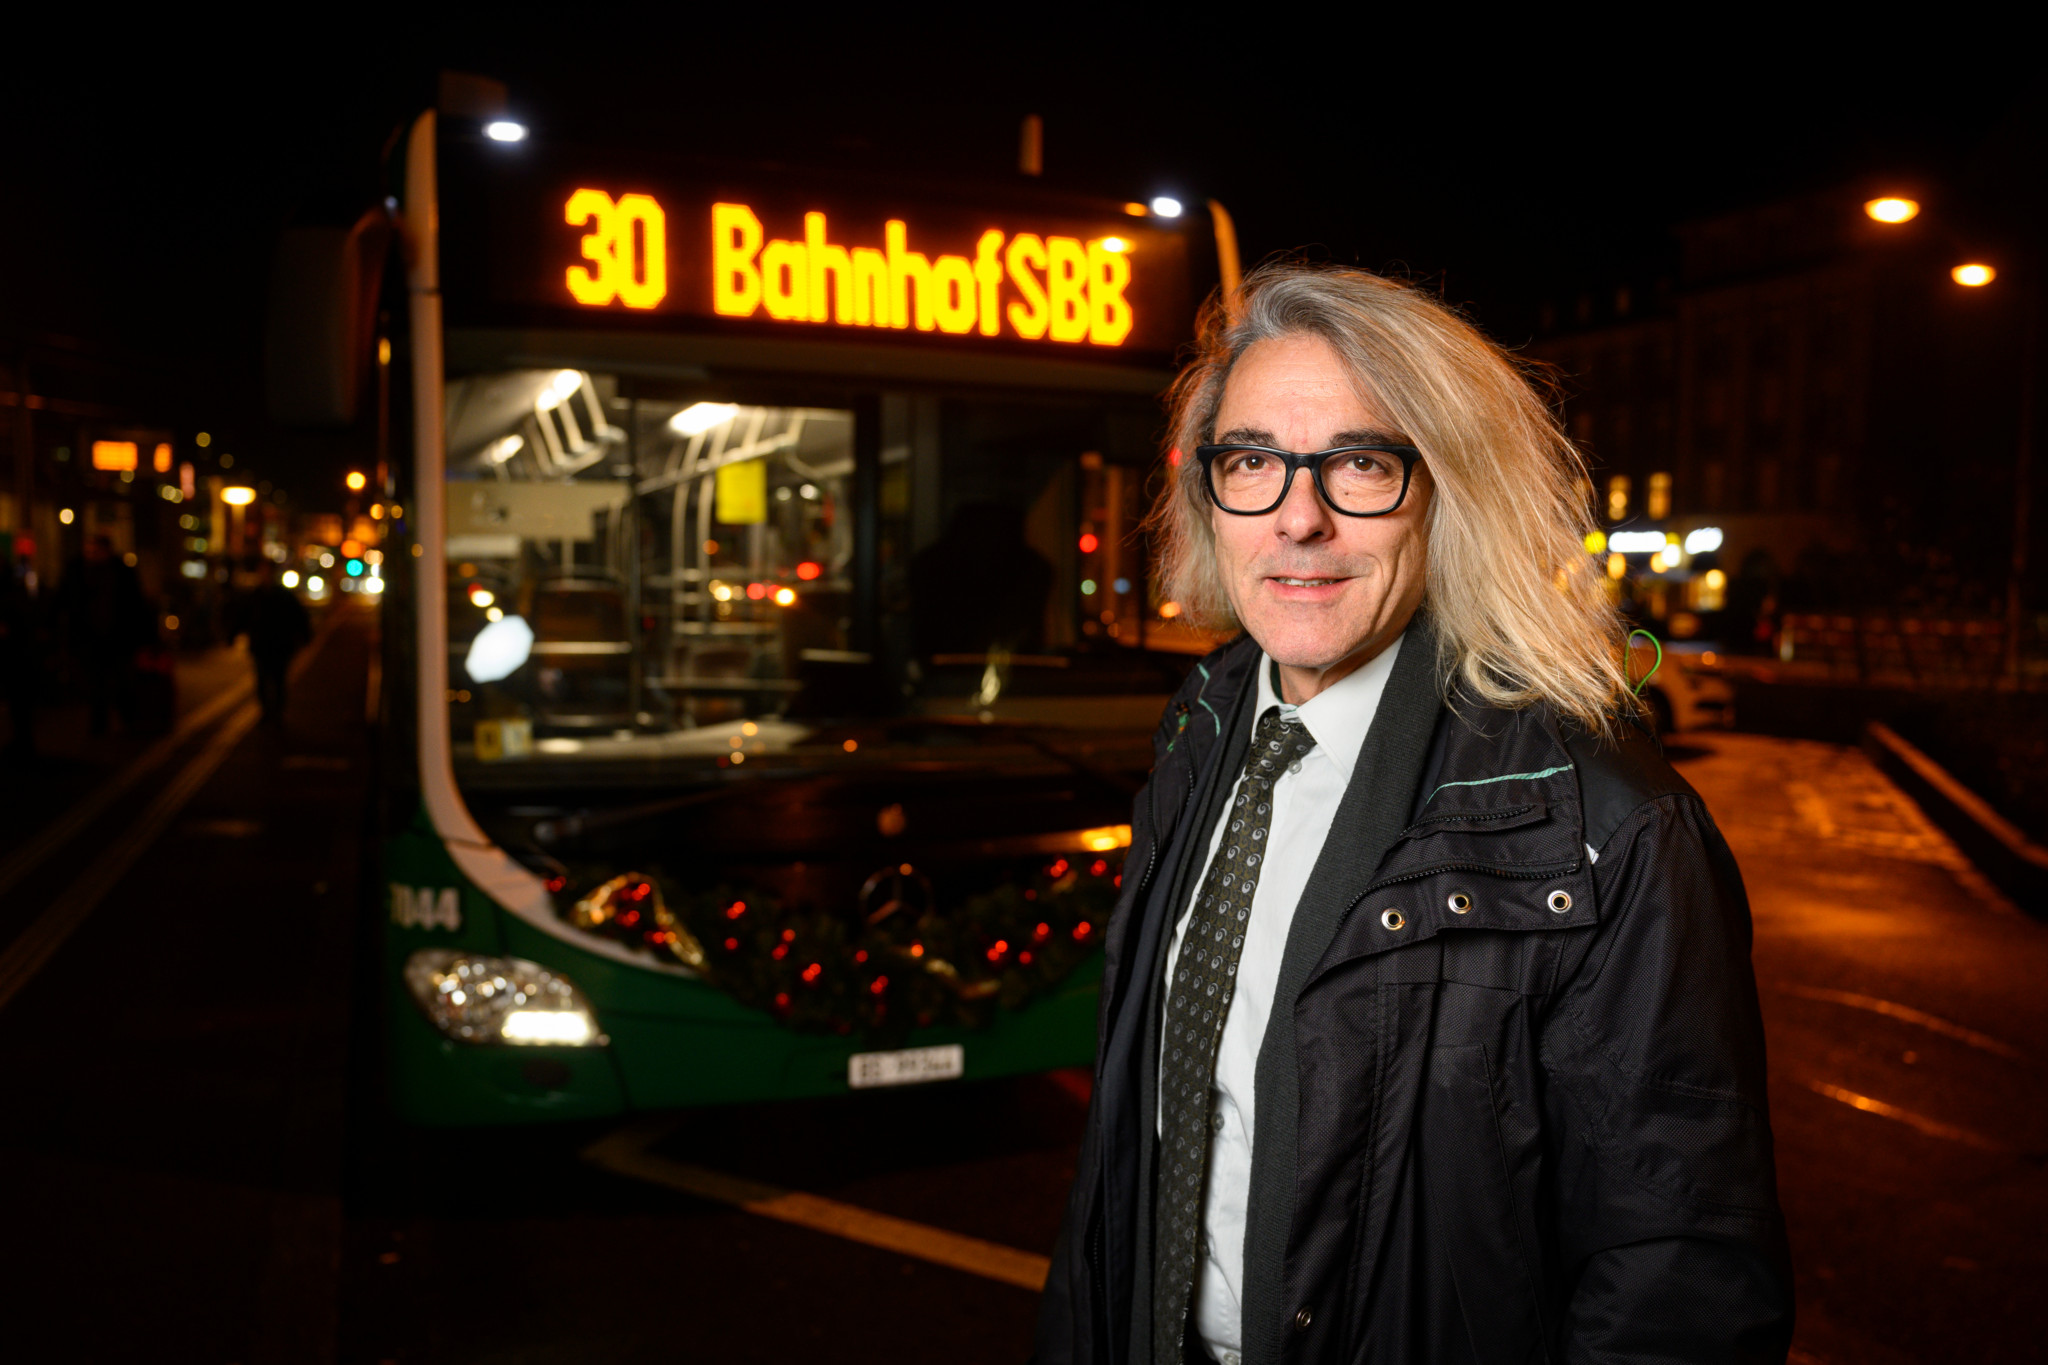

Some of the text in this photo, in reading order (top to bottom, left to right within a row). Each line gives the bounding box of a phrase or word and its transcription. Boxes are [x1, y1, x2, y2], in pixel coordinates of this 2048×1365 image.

[565, 188, 1134, 346] 30 Bahnhof SBB
